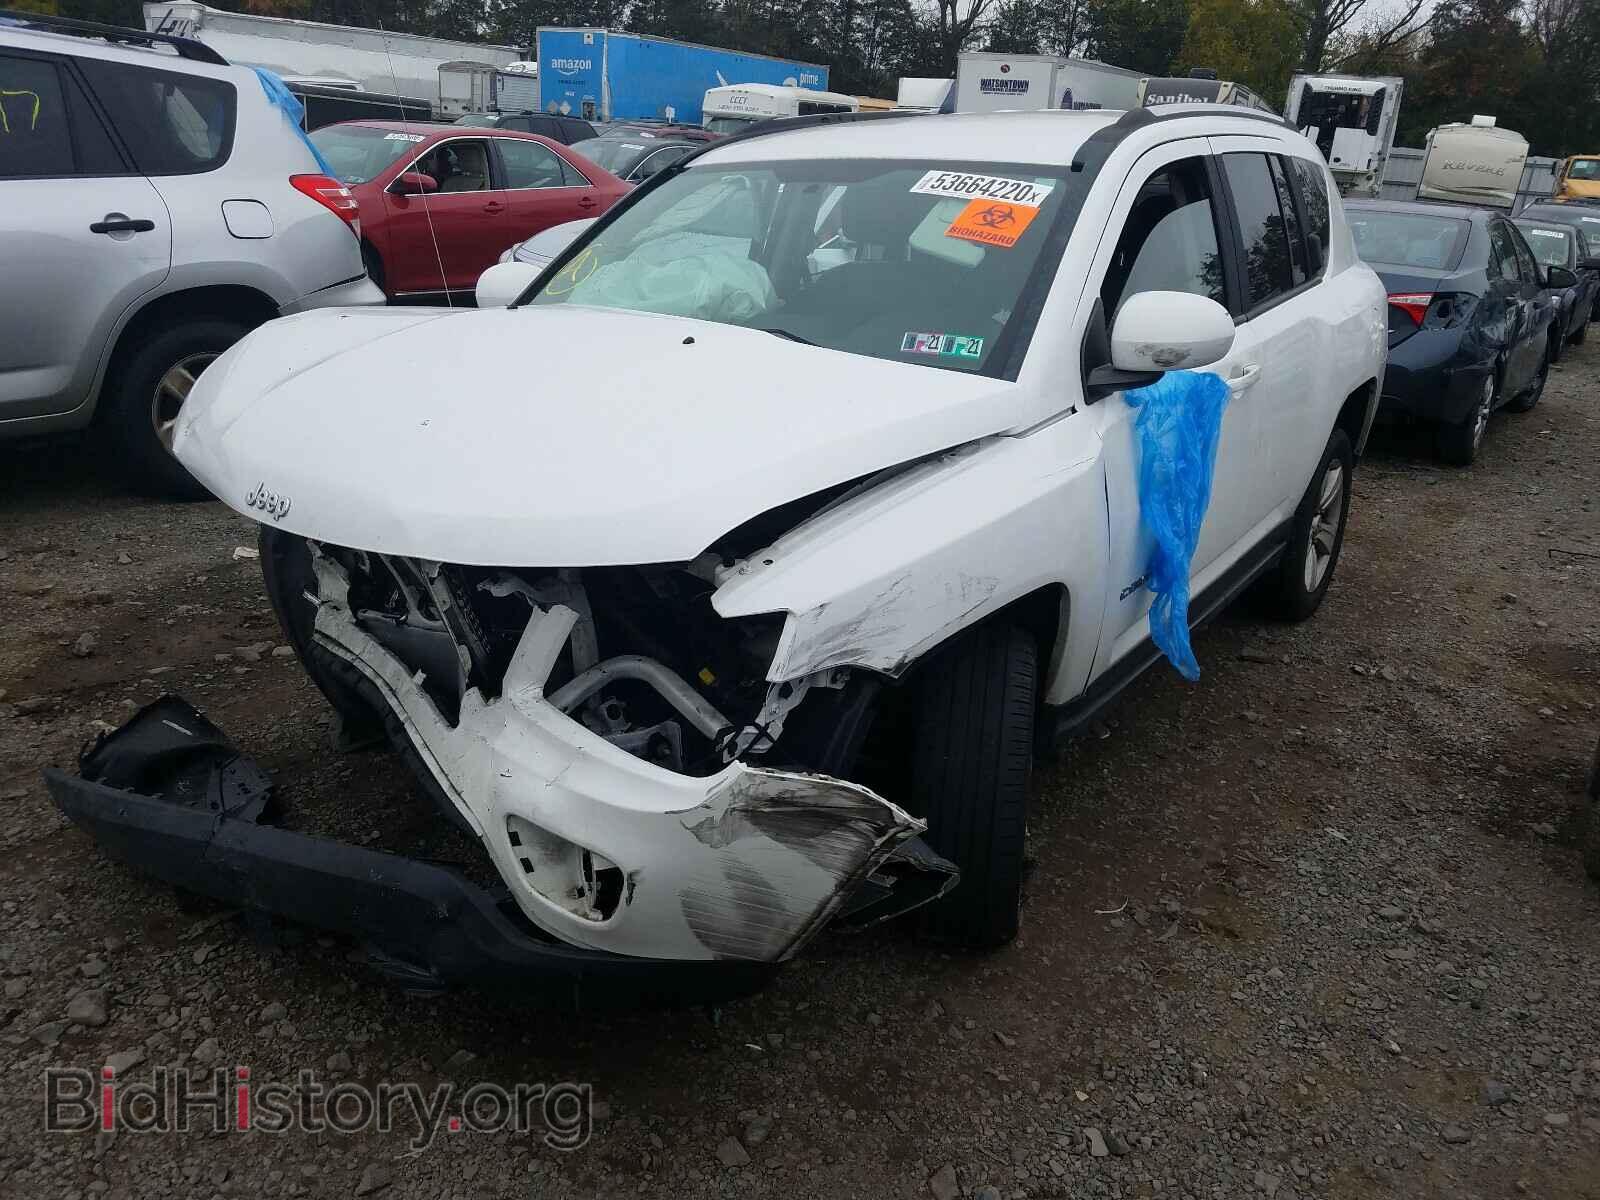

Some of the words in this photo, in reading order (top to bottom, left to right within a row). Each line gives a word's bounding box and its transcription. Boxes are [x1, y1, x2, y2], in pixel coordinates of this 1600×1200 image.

[551, 58, 592, 70] amazon
[800, 72, 819, 86] prime
[980, 79, 1030, 89] WATSONTOWN
[949, 226, 1015, 245] BIOHAZARD
[928, 335, 939, 350] 21
[967, 339, 979, 354] 21
[246, 482, 292, 521] Jeep
